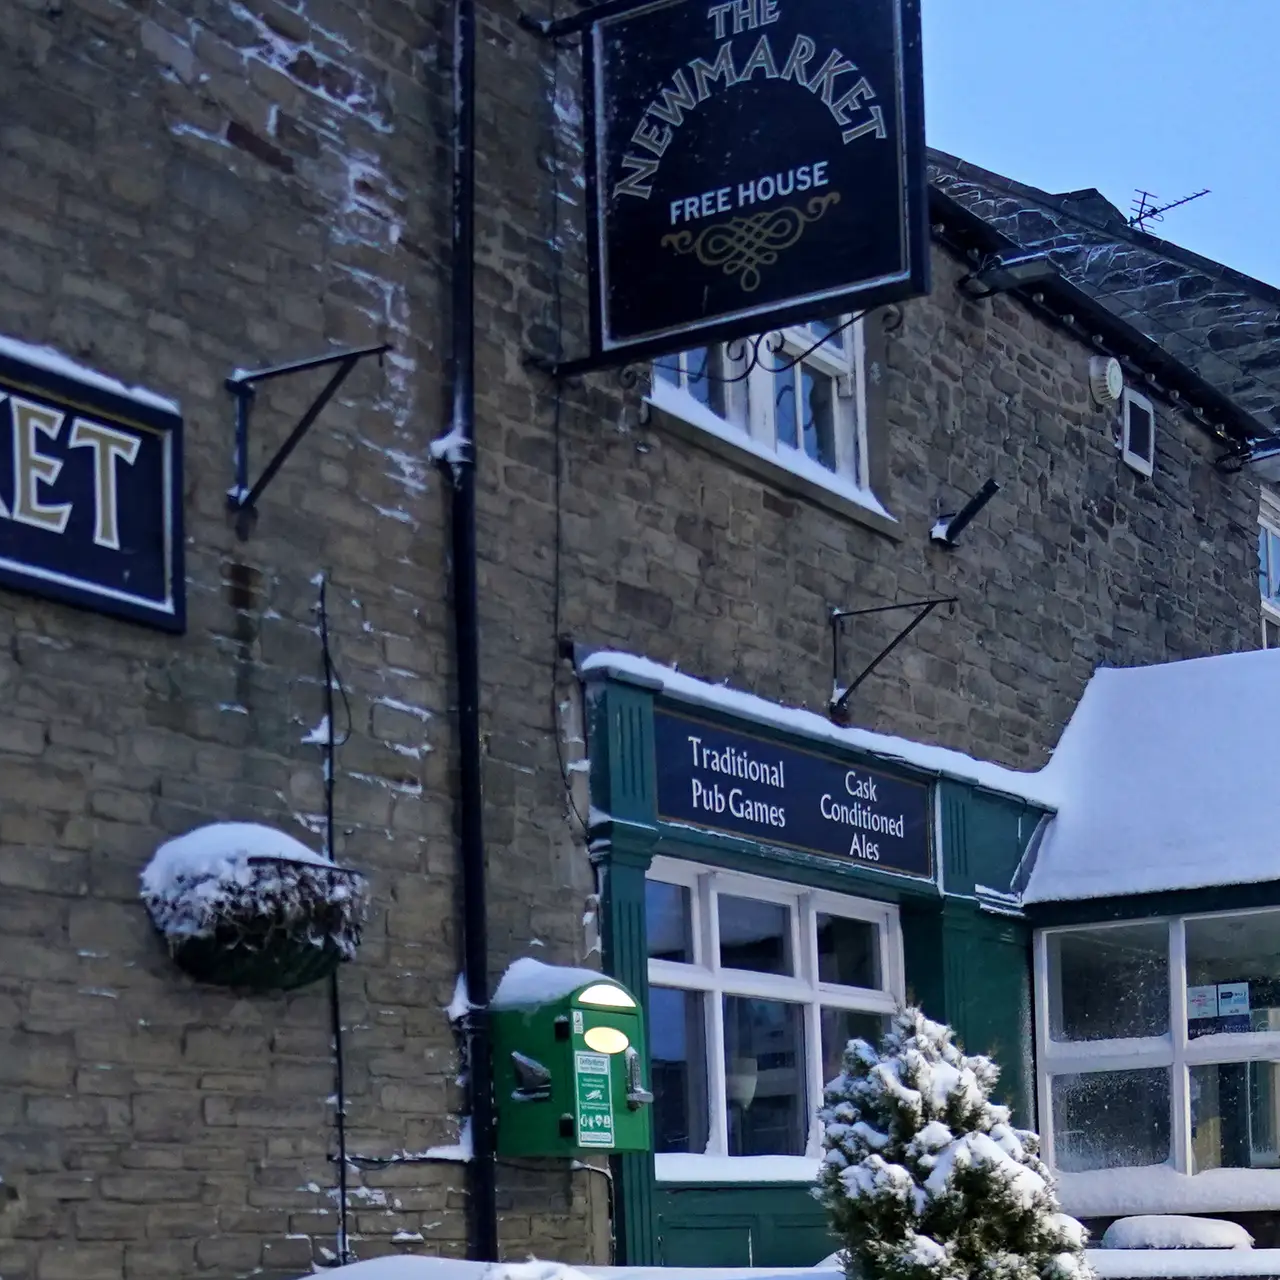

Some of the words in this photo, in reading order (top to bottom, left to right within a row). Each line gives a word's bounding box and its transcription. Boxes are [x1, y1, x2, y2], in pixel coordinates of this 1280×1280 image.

[707, 0, 781, 39] THE
[612, 33, 887, 199] NEWMARKET
[670, 187, 732, 225] FREE
[737, 160, 829, 208] HOUSE
[688, 736, 784, 789] Traditional
[845, 770, 877, 802] Cask
[692, 778, 725, 814] Pub
[728, 788, 785, 828] Games
[820, 793, 904, 838] Conditioned
[849, 833, 880, 861] Ales
